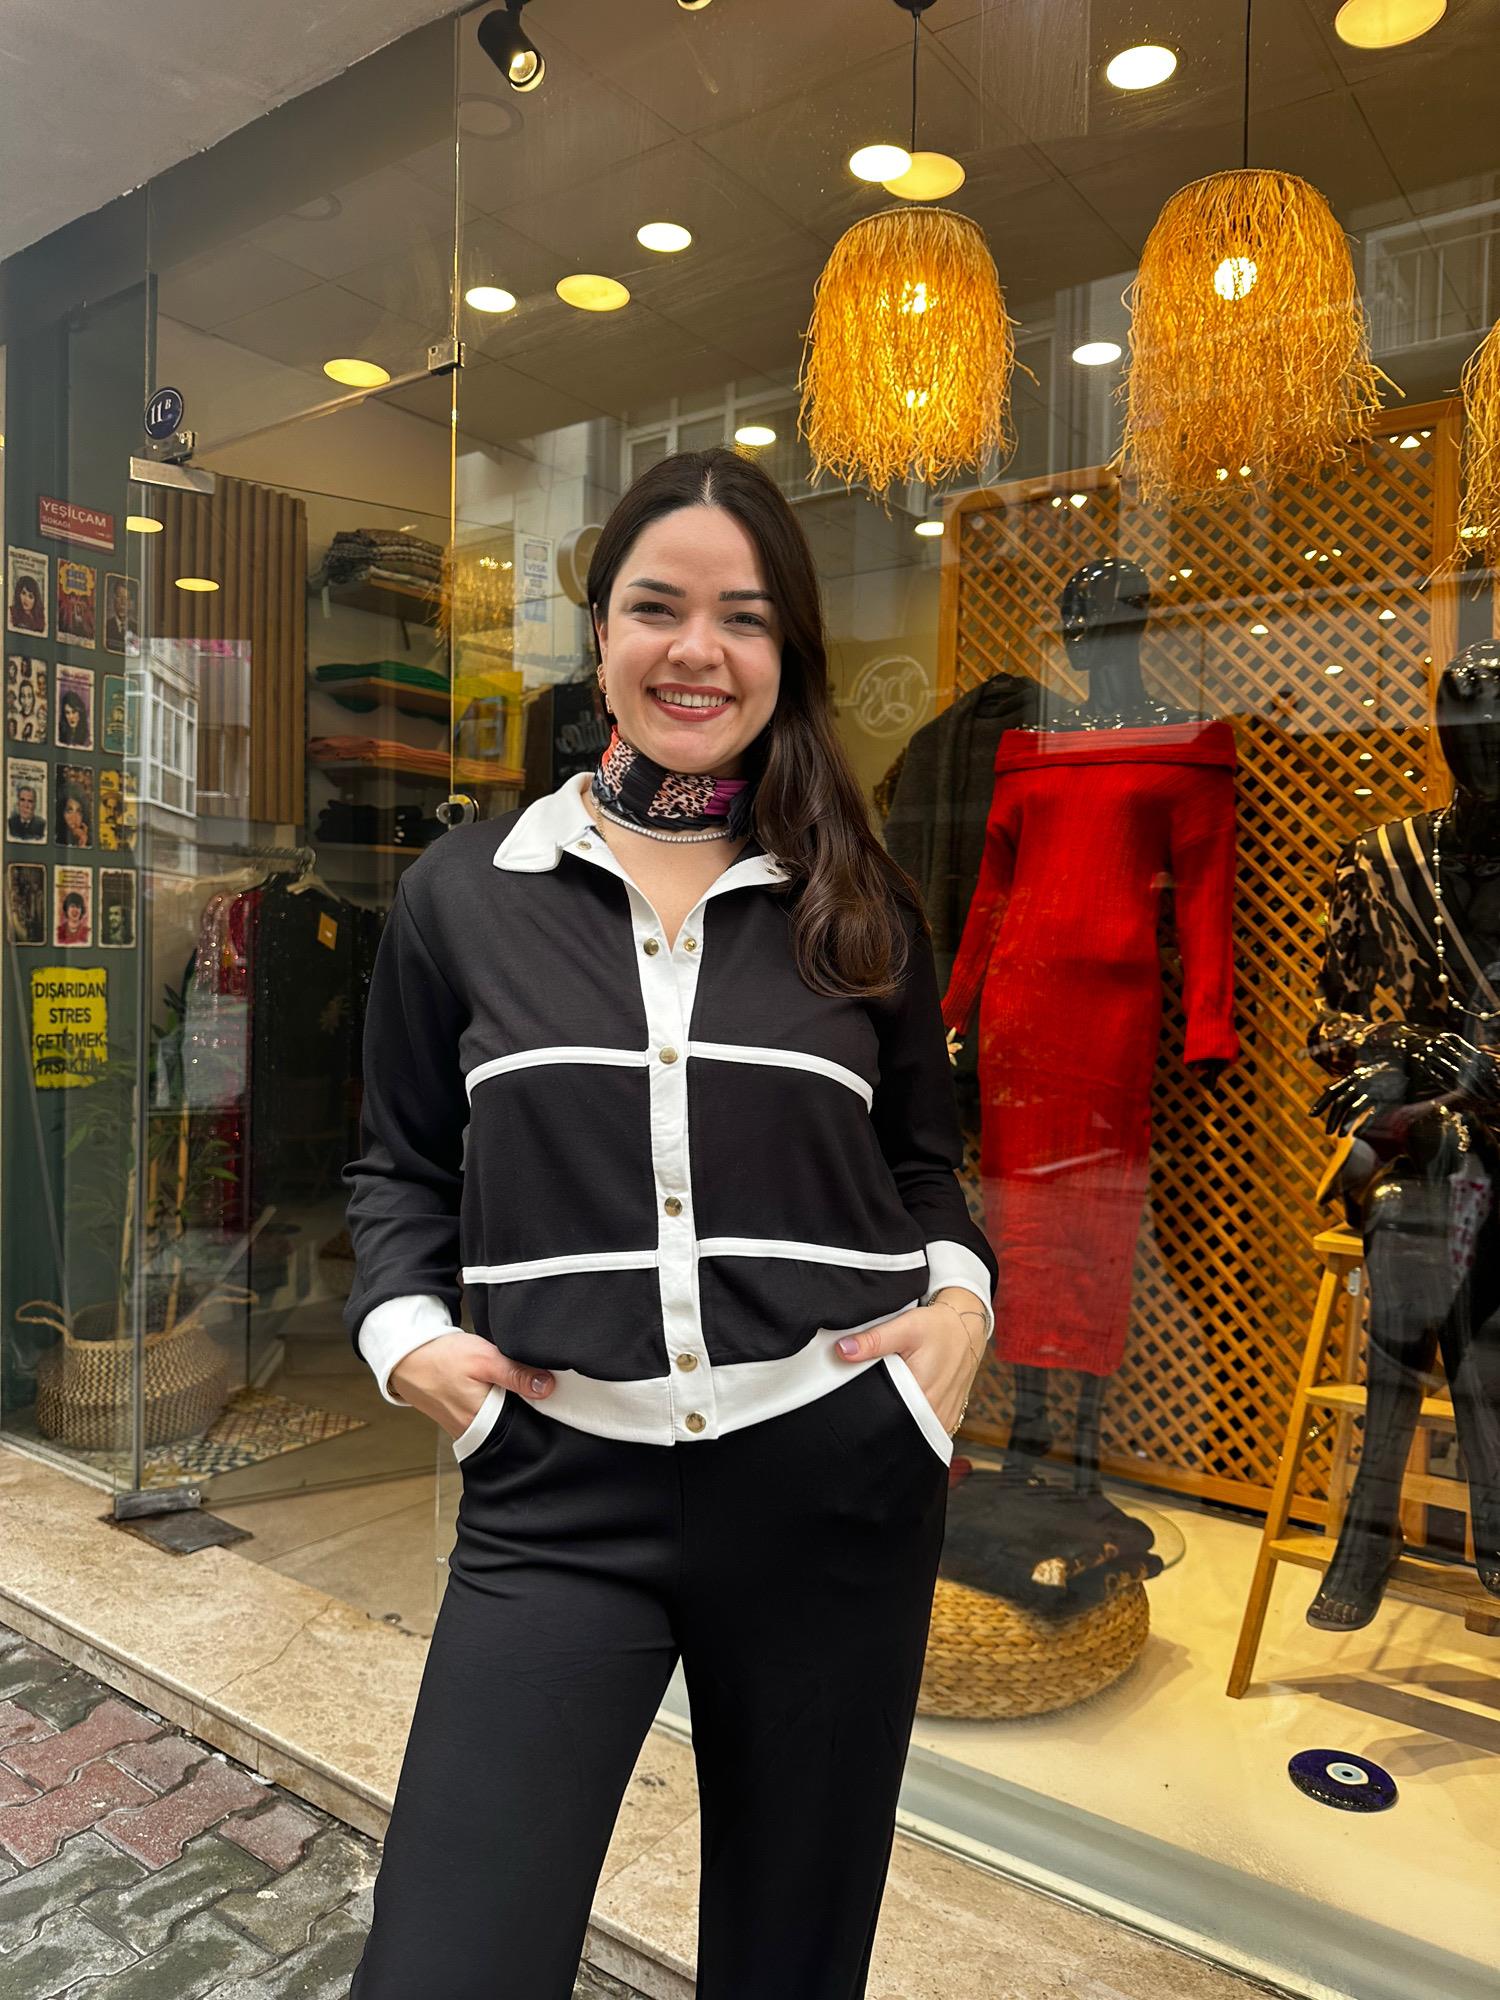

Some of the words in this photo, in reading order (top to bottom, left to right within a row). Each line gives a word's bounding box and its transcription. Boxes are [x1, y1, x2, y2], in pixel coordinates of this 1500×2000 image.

[41, 500, 107, 527] YEŞİLÇAM
[34, 982, 106, 1002] DIŞARIDAN
[49, 1007, 92, 1024] STRES
